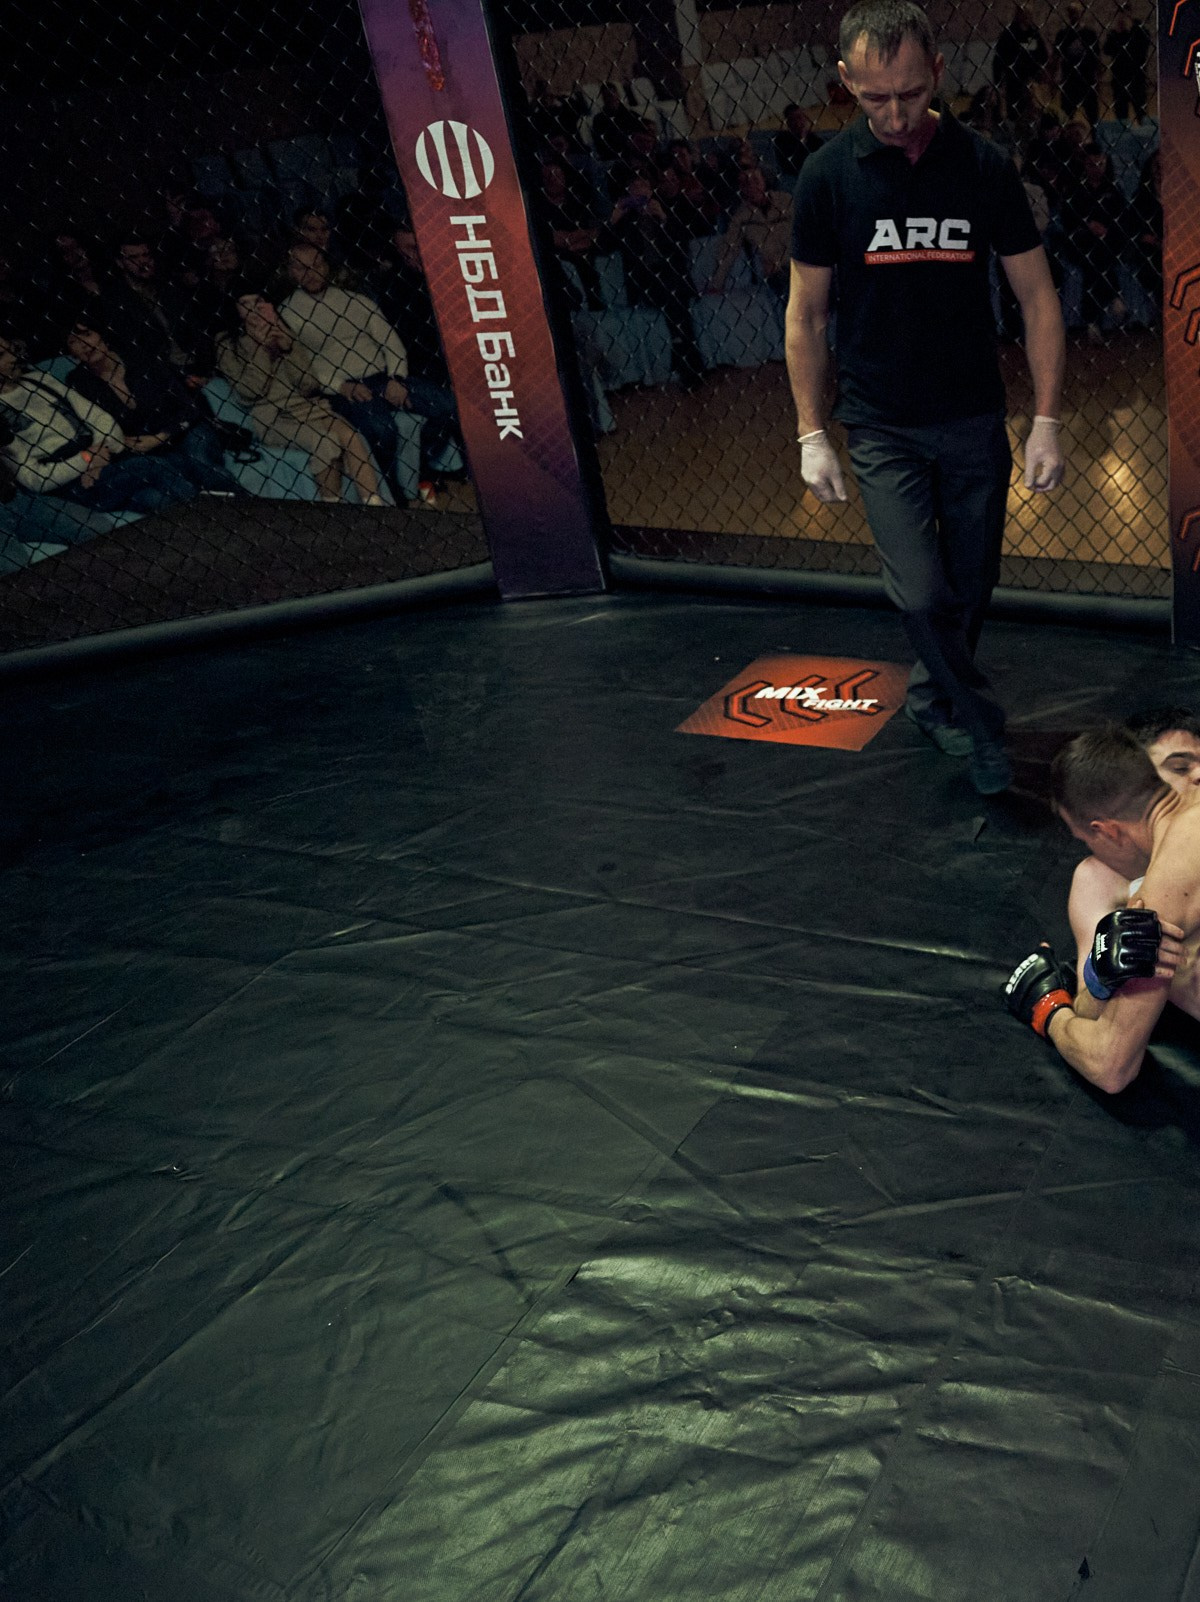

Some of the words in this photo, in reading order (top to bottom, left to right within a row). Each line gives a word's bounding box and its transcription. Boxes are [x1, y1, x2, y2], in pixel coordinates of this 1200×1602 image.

[866, 217, 971, 252] ARC
[869, 252, 926, 262] INTERNATIONAL
[927, 250, 973, 260] FEDERATION
[449, 214, 507, 323] НБД
[476, 331, 524, 441] Банк
[755, 686, 828, 700] MIX
[803, 698, 878, 711] FIGHT
